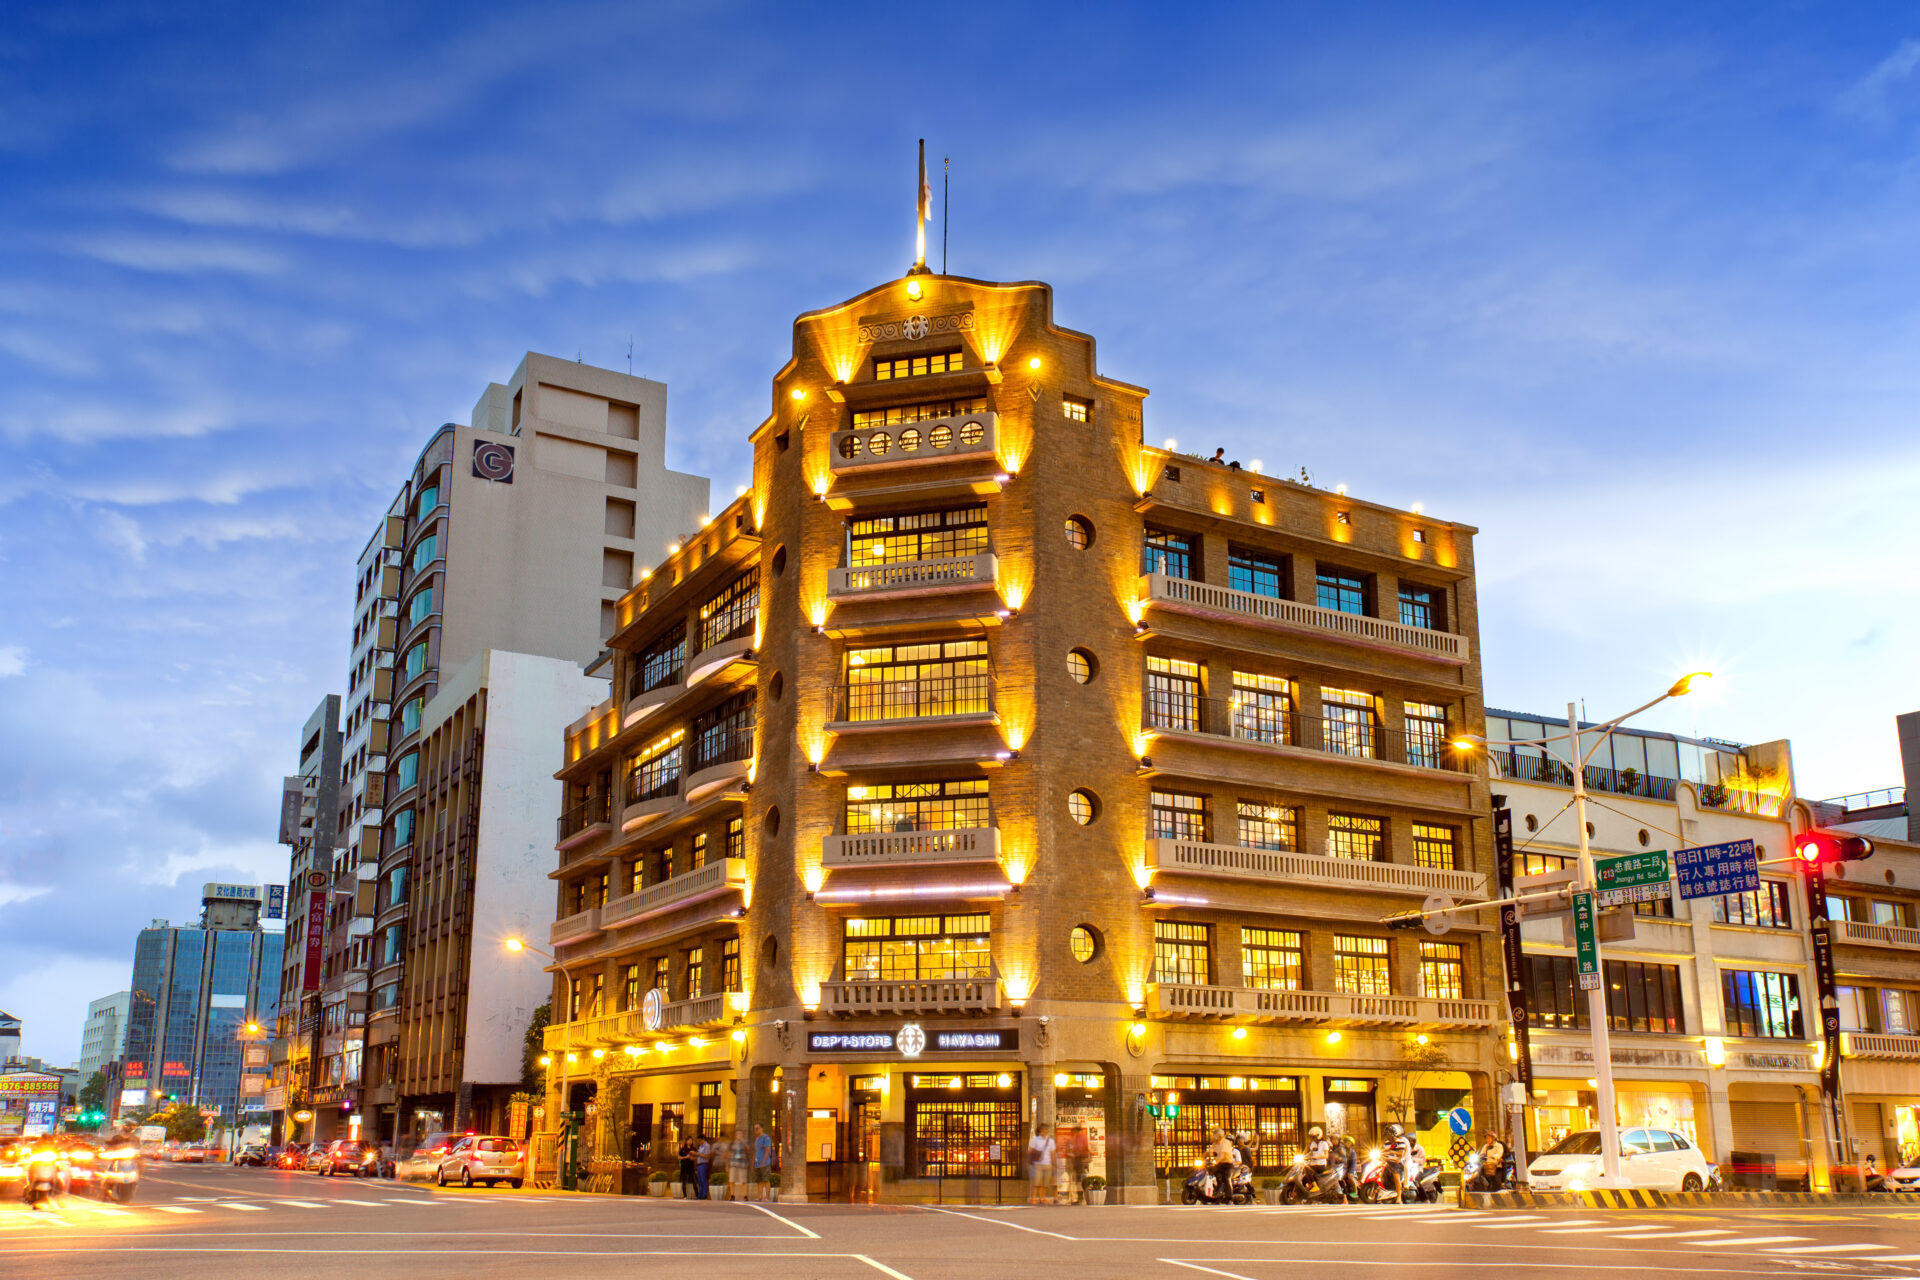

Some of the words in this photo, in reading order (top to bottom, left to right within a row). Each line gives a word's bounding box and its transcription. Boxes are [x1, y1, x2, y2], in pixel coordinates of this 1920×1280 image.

[1615, 856, 1661, 873] 忠義路二段
[1676, 842, 1754, 865] 假日11時-22時
[1679, 859, 1757, 881] 行人專用時相
[1681, 875, 1760, 897] 請依號誌行駛
[938, 1034, 1000, 1048] HAYASHI
